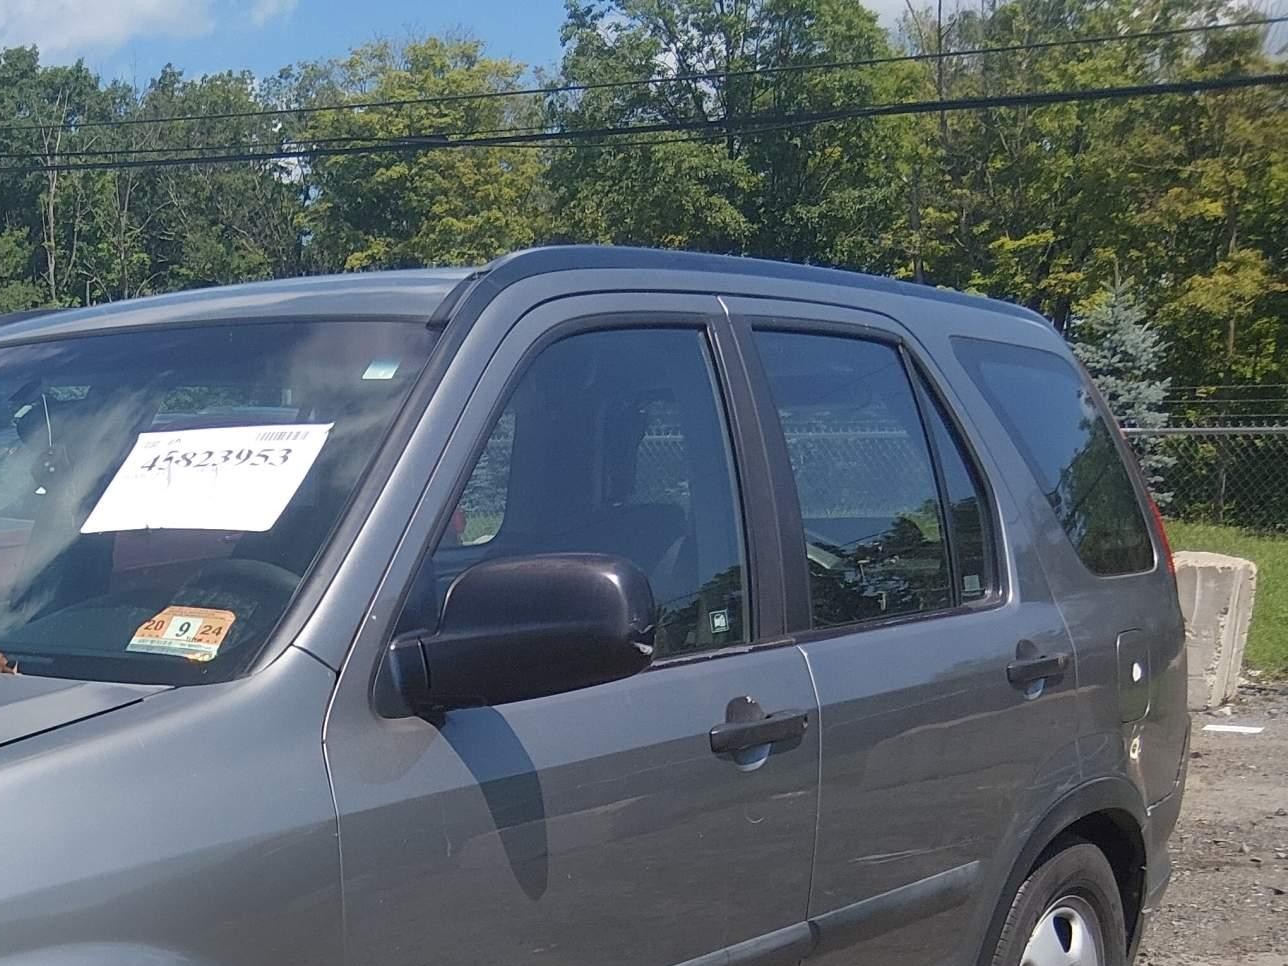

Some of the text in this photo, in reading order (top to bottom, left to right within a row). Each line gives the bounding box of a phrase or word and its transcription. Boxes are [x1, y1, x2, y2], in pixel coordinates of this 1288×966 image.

[141, 448, 292, 472] 45823953
[144, 619, 223, 638] 20 9 24
